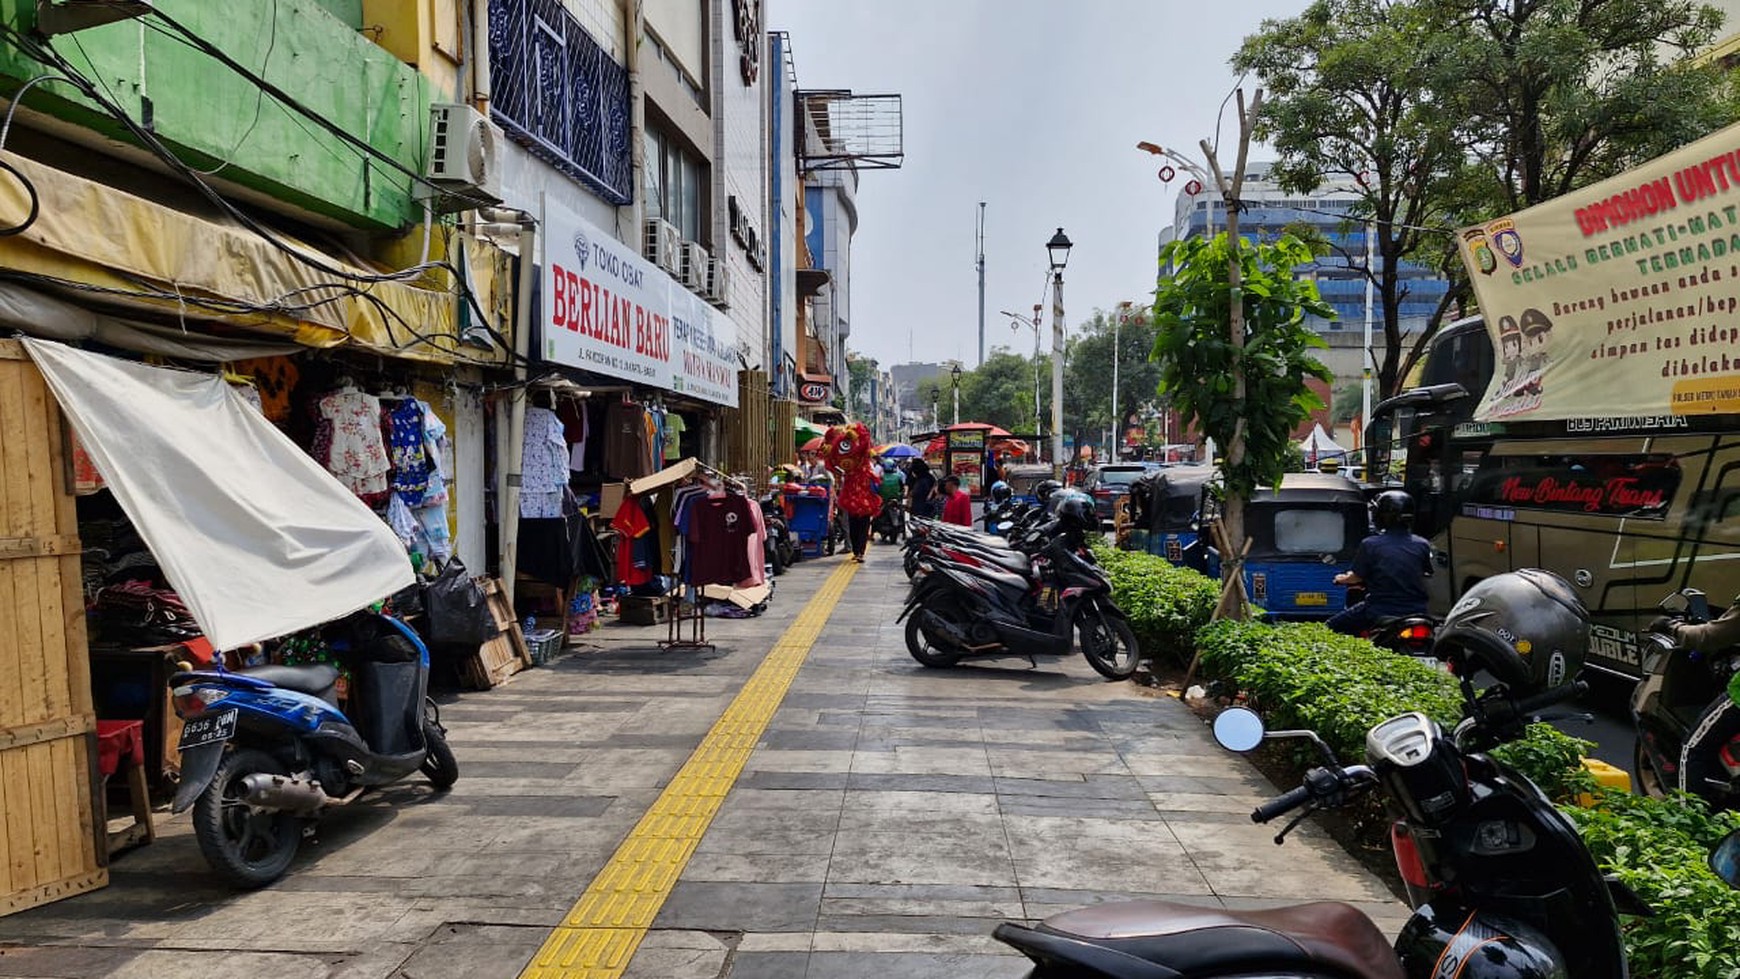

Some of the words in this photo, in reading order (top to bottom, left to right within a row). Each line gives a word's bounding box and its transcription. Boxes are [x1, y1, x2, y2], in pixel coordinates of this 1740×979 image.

[1574, 176, 1677, 238] DIMOHON
[592, 243, 620, 279] TOKO
[621, 259, 644, 291] OBAT
[1511, 255, 1578, 285] SELALU
[1585, 204, 1737, 265] BERHATI-HAT
[552, 264, 631, 350] BERLIAN
[635, 304, 670, 363] BARU
[1553, 296, 1605, 317] Barang
[1611, 281, 1670, 304] bawaan
[1679, 265, 1721, 289] anda
[1607, 295, 1737, 336] perjalanan/bep
[1591, 342, 1648, 360] simpan
[1656, 336, 1681, 351] tas
[1690, 324, 1738, 345] didep
[1502, 476, 1534, 502] New
[1534, 476, 1602, 511] Bintang
[1606, 477, 1664, 507] Trans
